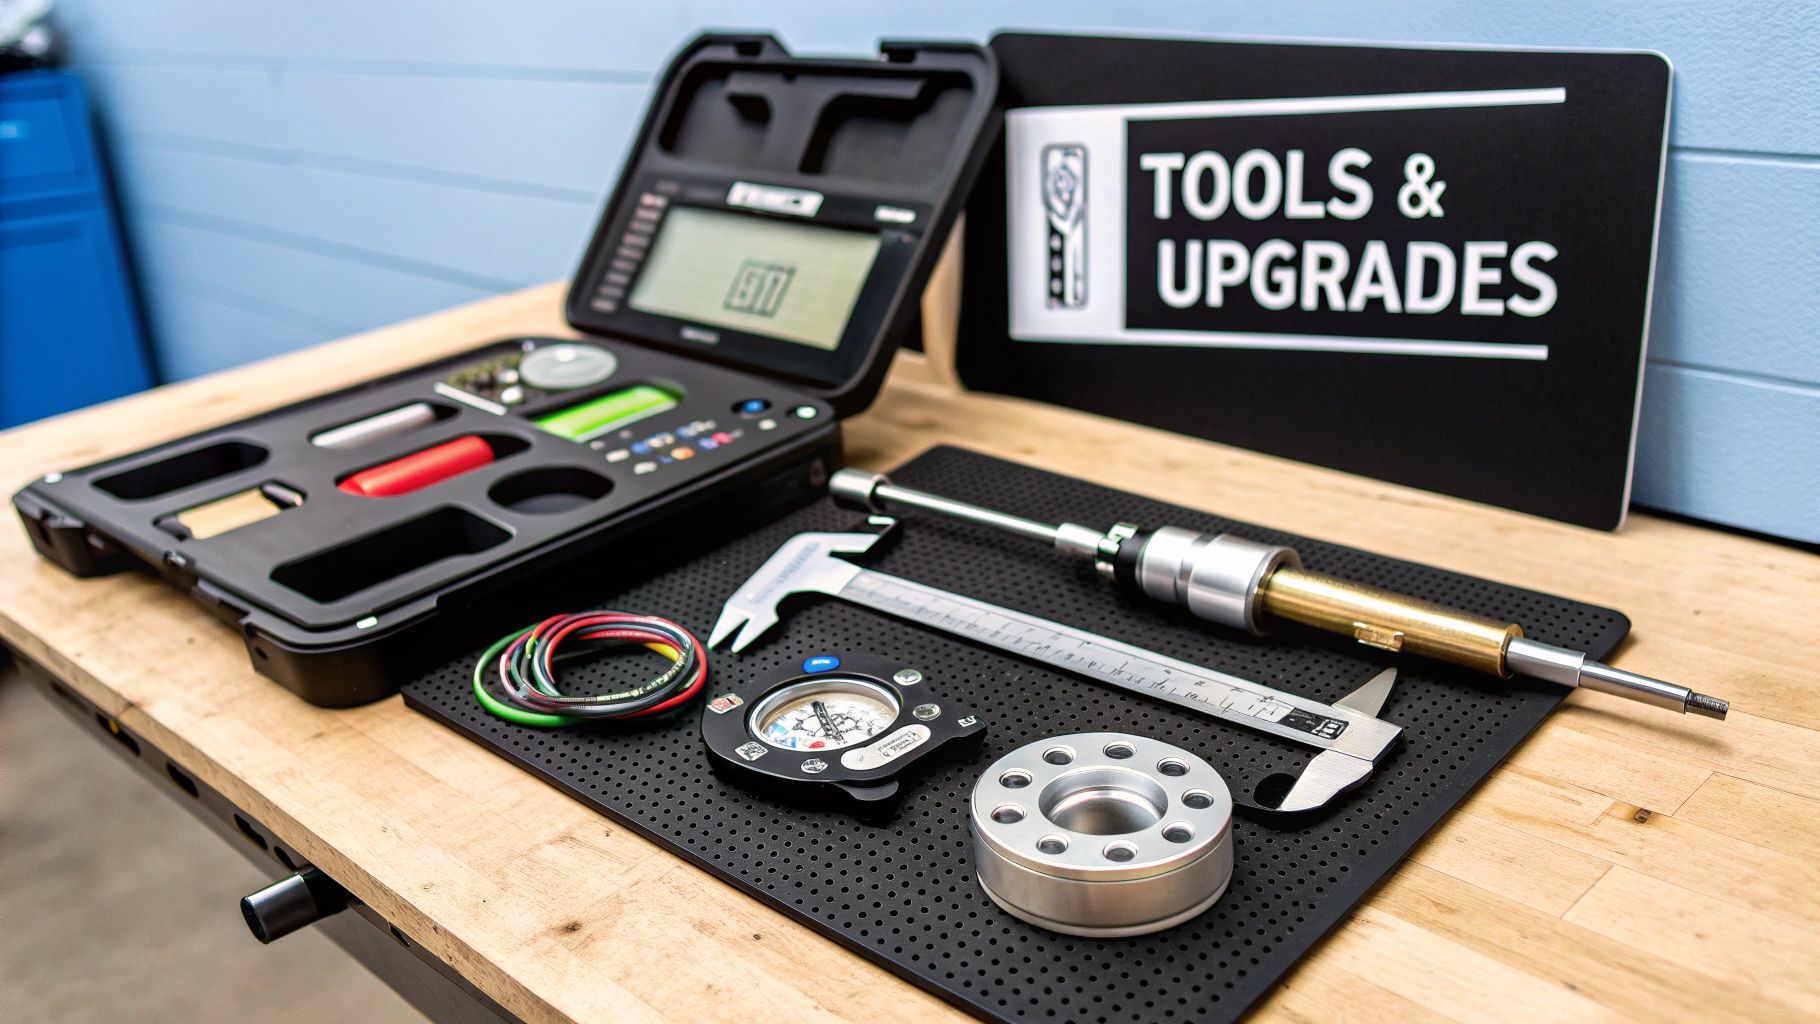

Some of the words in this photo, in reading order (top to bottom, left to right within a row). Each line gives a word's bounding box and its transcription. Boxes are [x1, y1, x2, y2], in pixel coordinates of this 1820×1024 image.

[1140, 147, 1374, 220] TOOLS
[1397, 153, 1447, 219] &
[1158, 239, 1559, 317] UPGRADES
